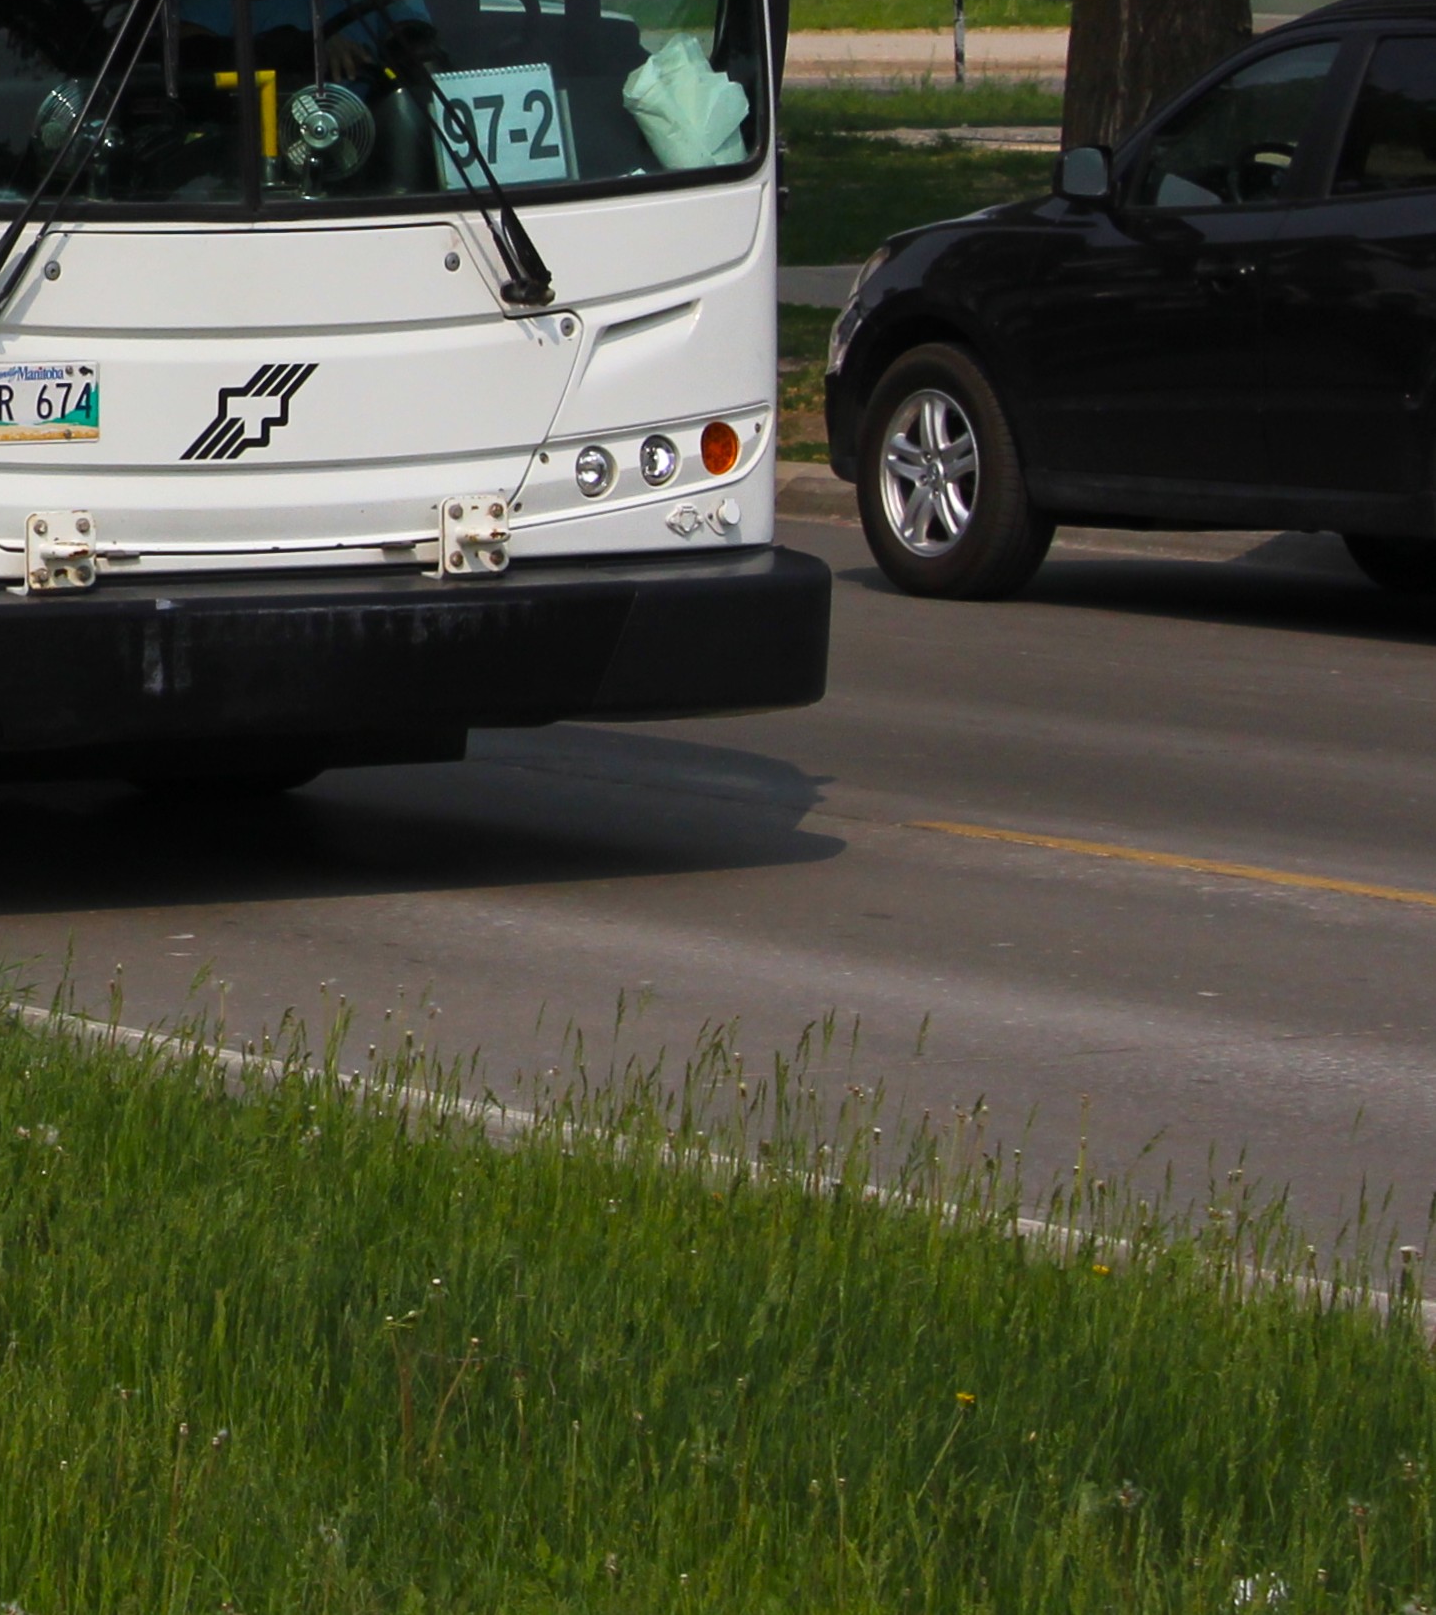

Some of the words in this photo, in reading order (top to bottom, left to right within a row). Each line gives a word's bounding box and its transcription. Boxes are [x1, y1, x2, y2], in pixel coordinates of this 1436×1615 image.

[443, 89, 560, 168] 97-2
[17, 366, 65, 381] Manitoba
[36, 382, 93, 420] 674
